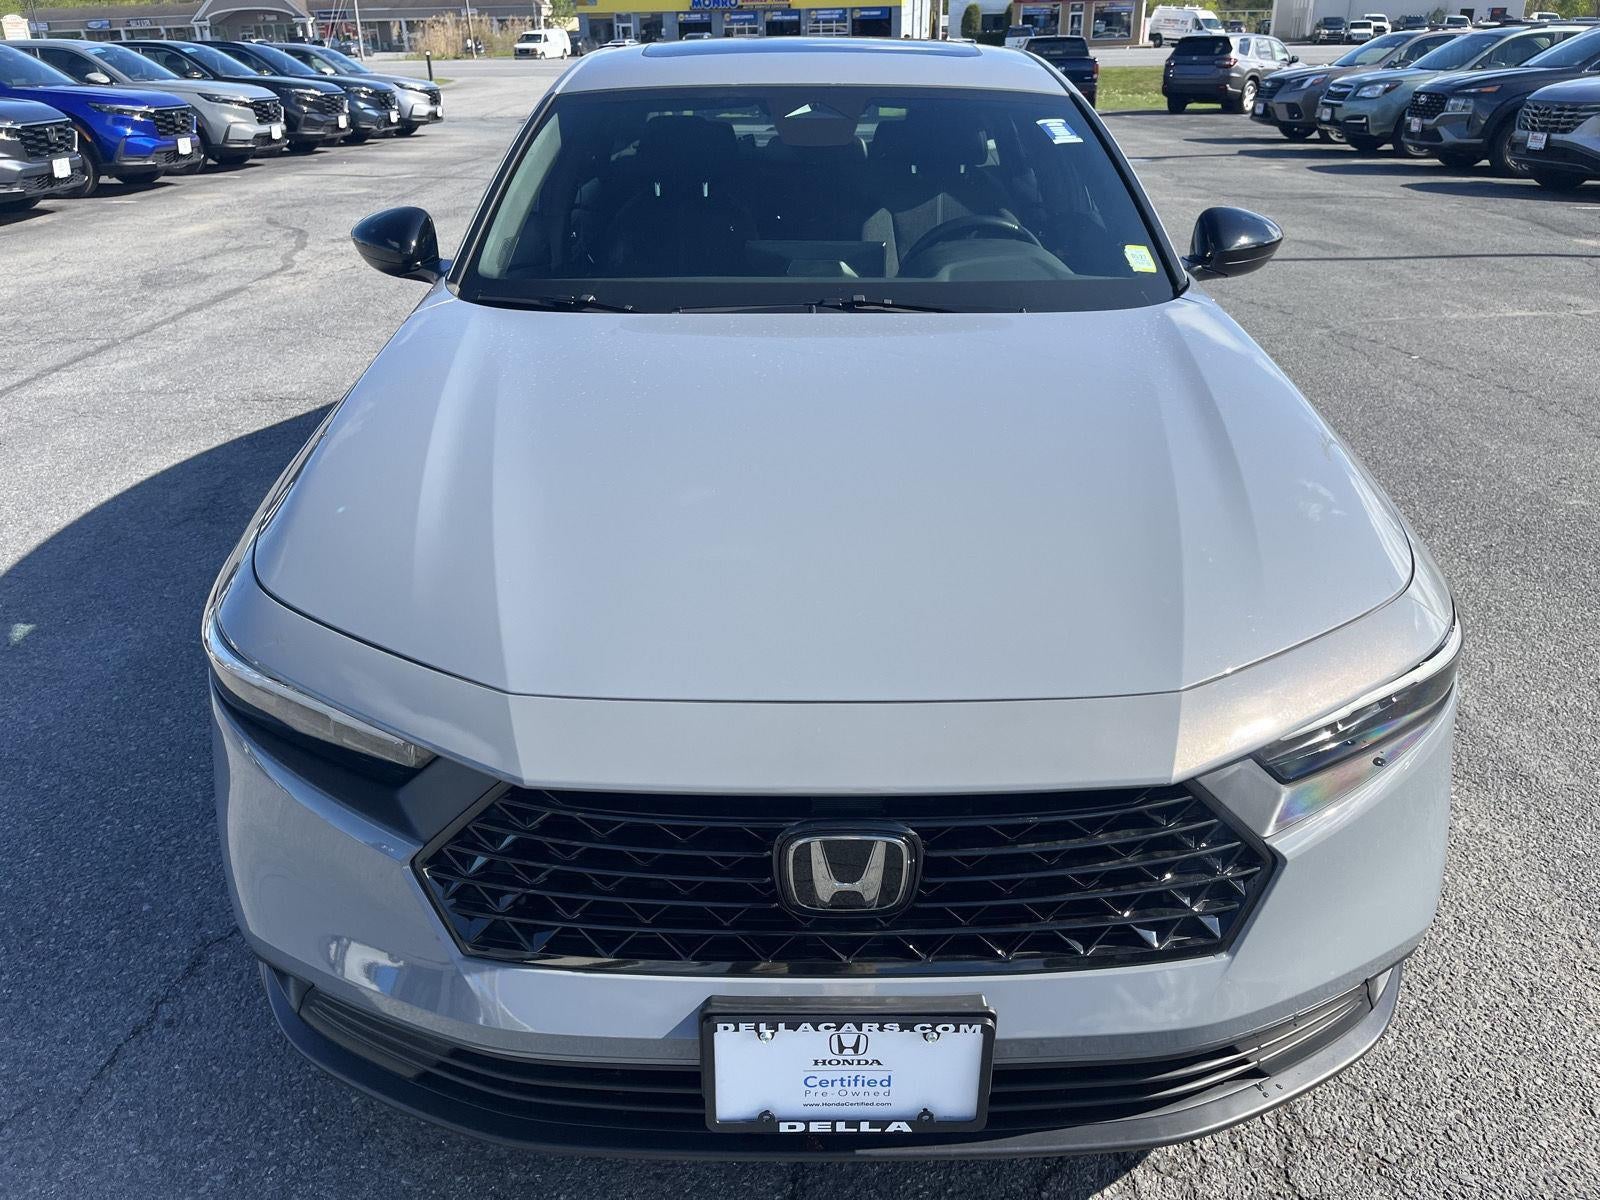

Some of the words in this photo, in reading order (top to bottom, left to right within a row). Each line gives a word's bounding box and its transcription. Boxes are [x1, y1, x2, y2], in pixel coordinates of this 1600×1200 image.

[716, 1022, 983, 1034] DELLACARS.COM
[803, 1075, 892, 1088] Certified
[804, 1089, 891, 1097] Pre-Owned
[779, 1121, 913, 1133] DELLA
